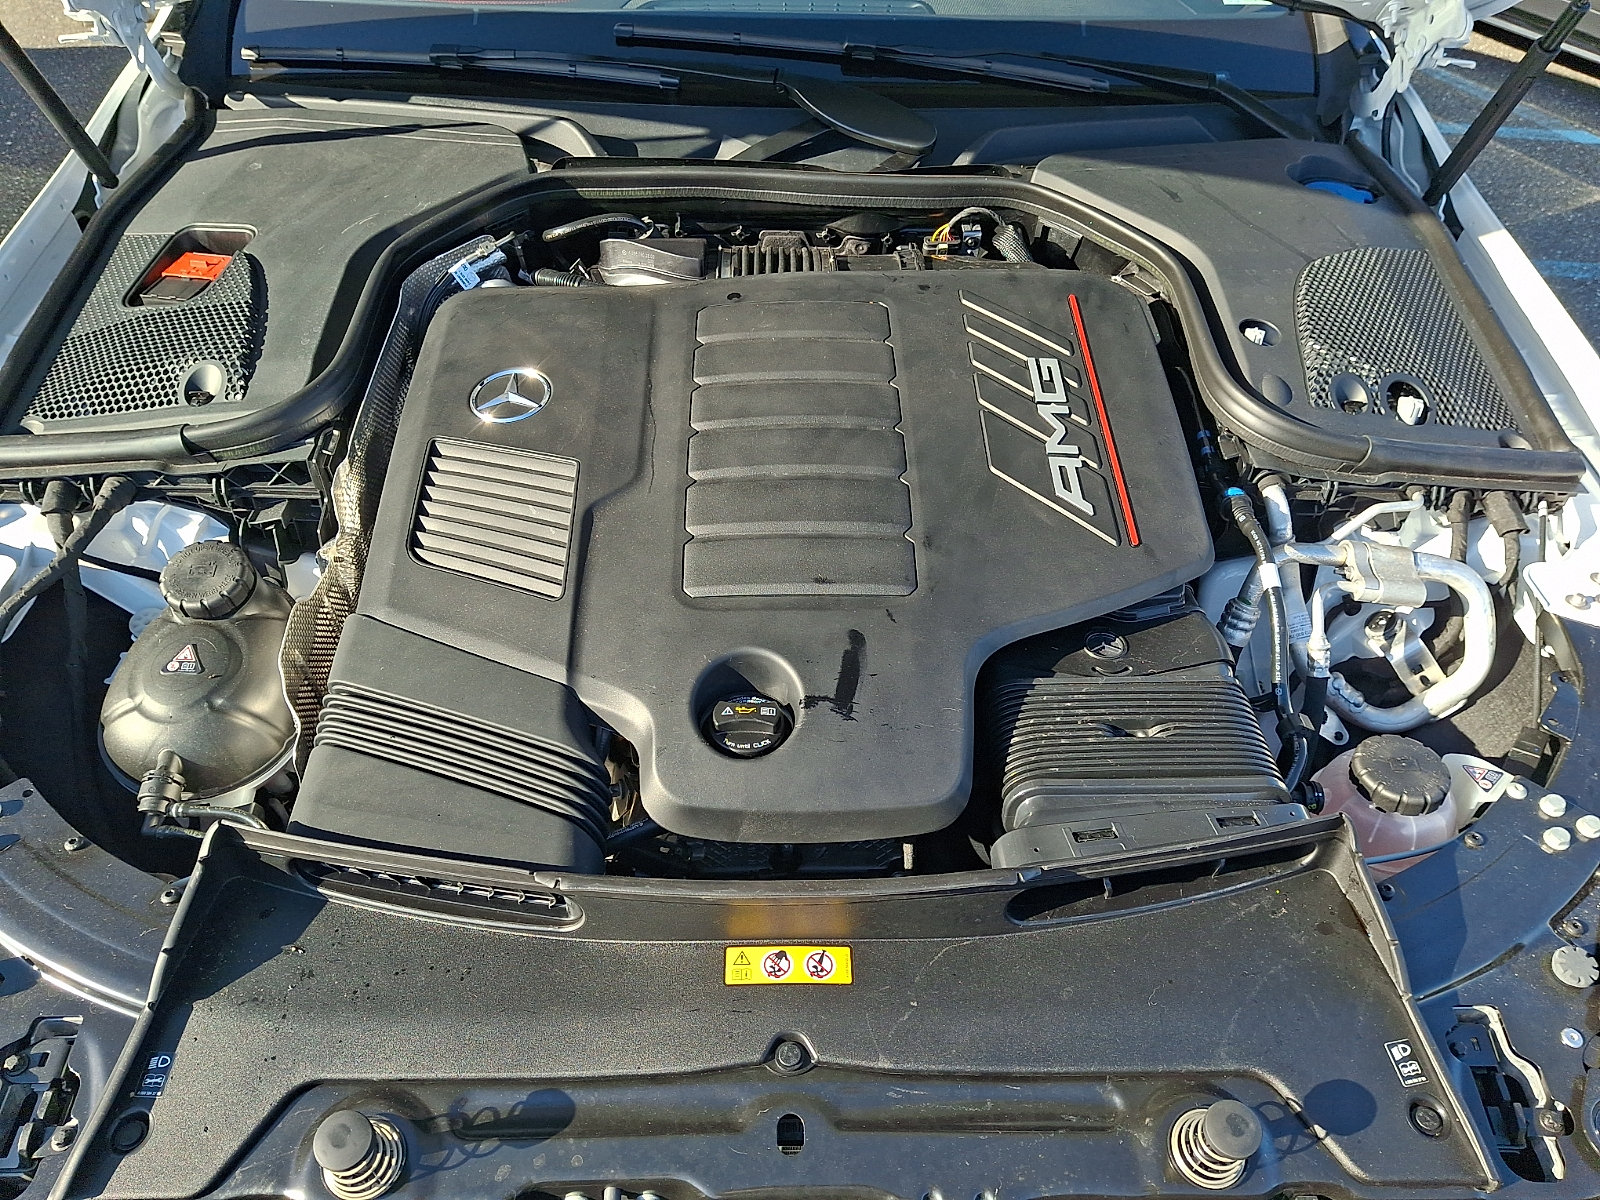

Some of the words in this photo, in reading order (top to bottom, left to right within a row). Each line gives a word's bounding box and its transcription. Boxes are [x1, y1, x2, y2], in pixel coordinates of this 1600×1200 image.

[1027, 357, 1095, 517] AMG
[195, 544, 214, 552] OPEN
[752, 739, 772, 748] CLICK
